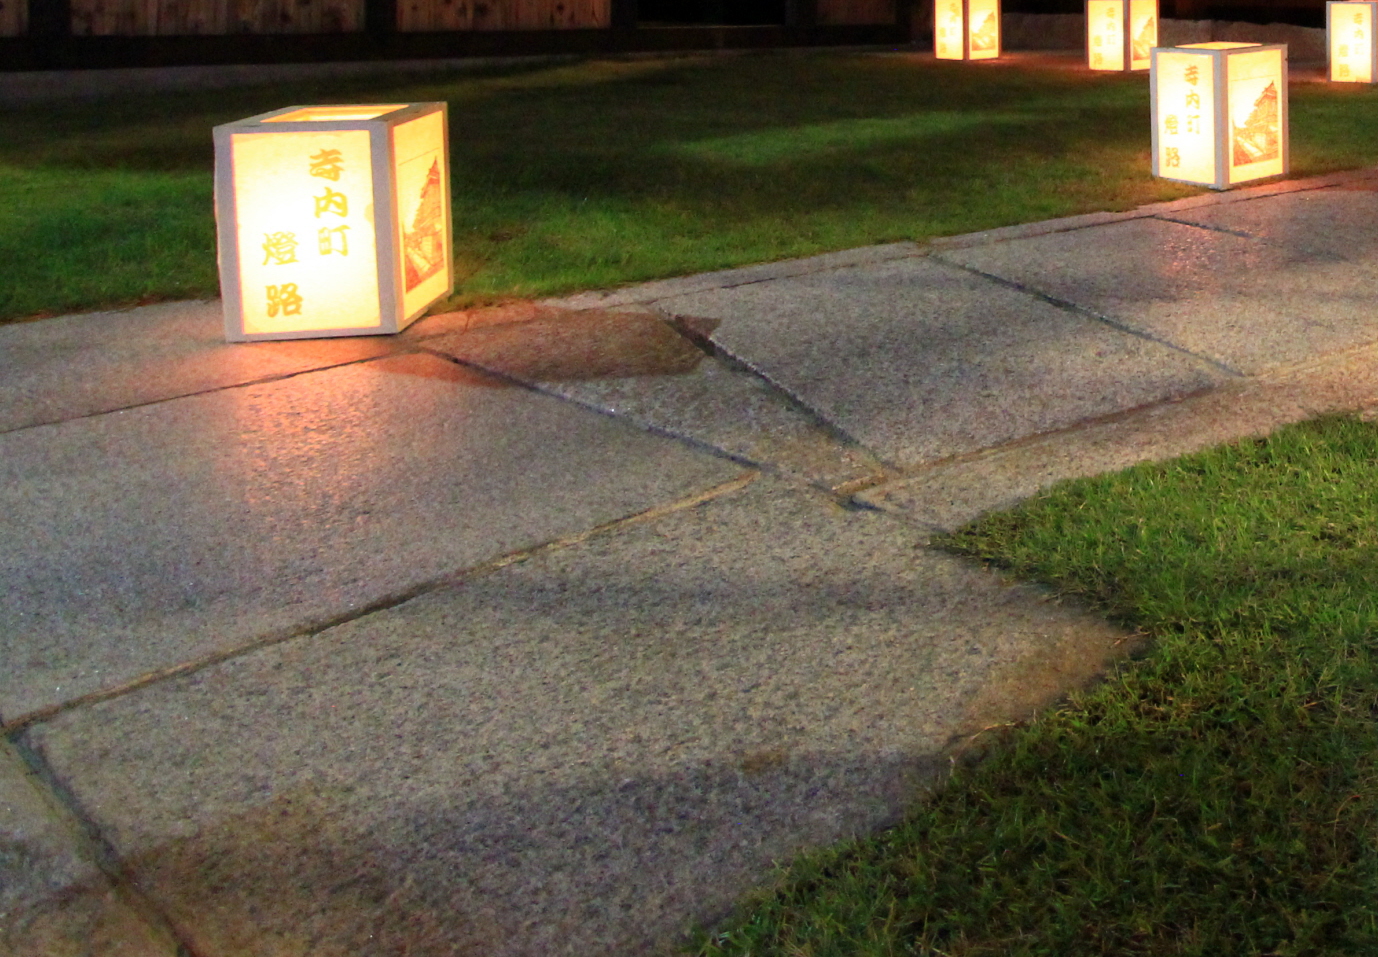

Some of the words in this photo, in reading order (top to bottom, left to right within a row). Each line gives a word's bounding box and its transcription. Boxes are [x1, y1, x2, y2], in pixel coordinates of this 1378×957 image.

[309, 149, 351, 257] 寺内町
[262, 231, 303, 318] 燈路
